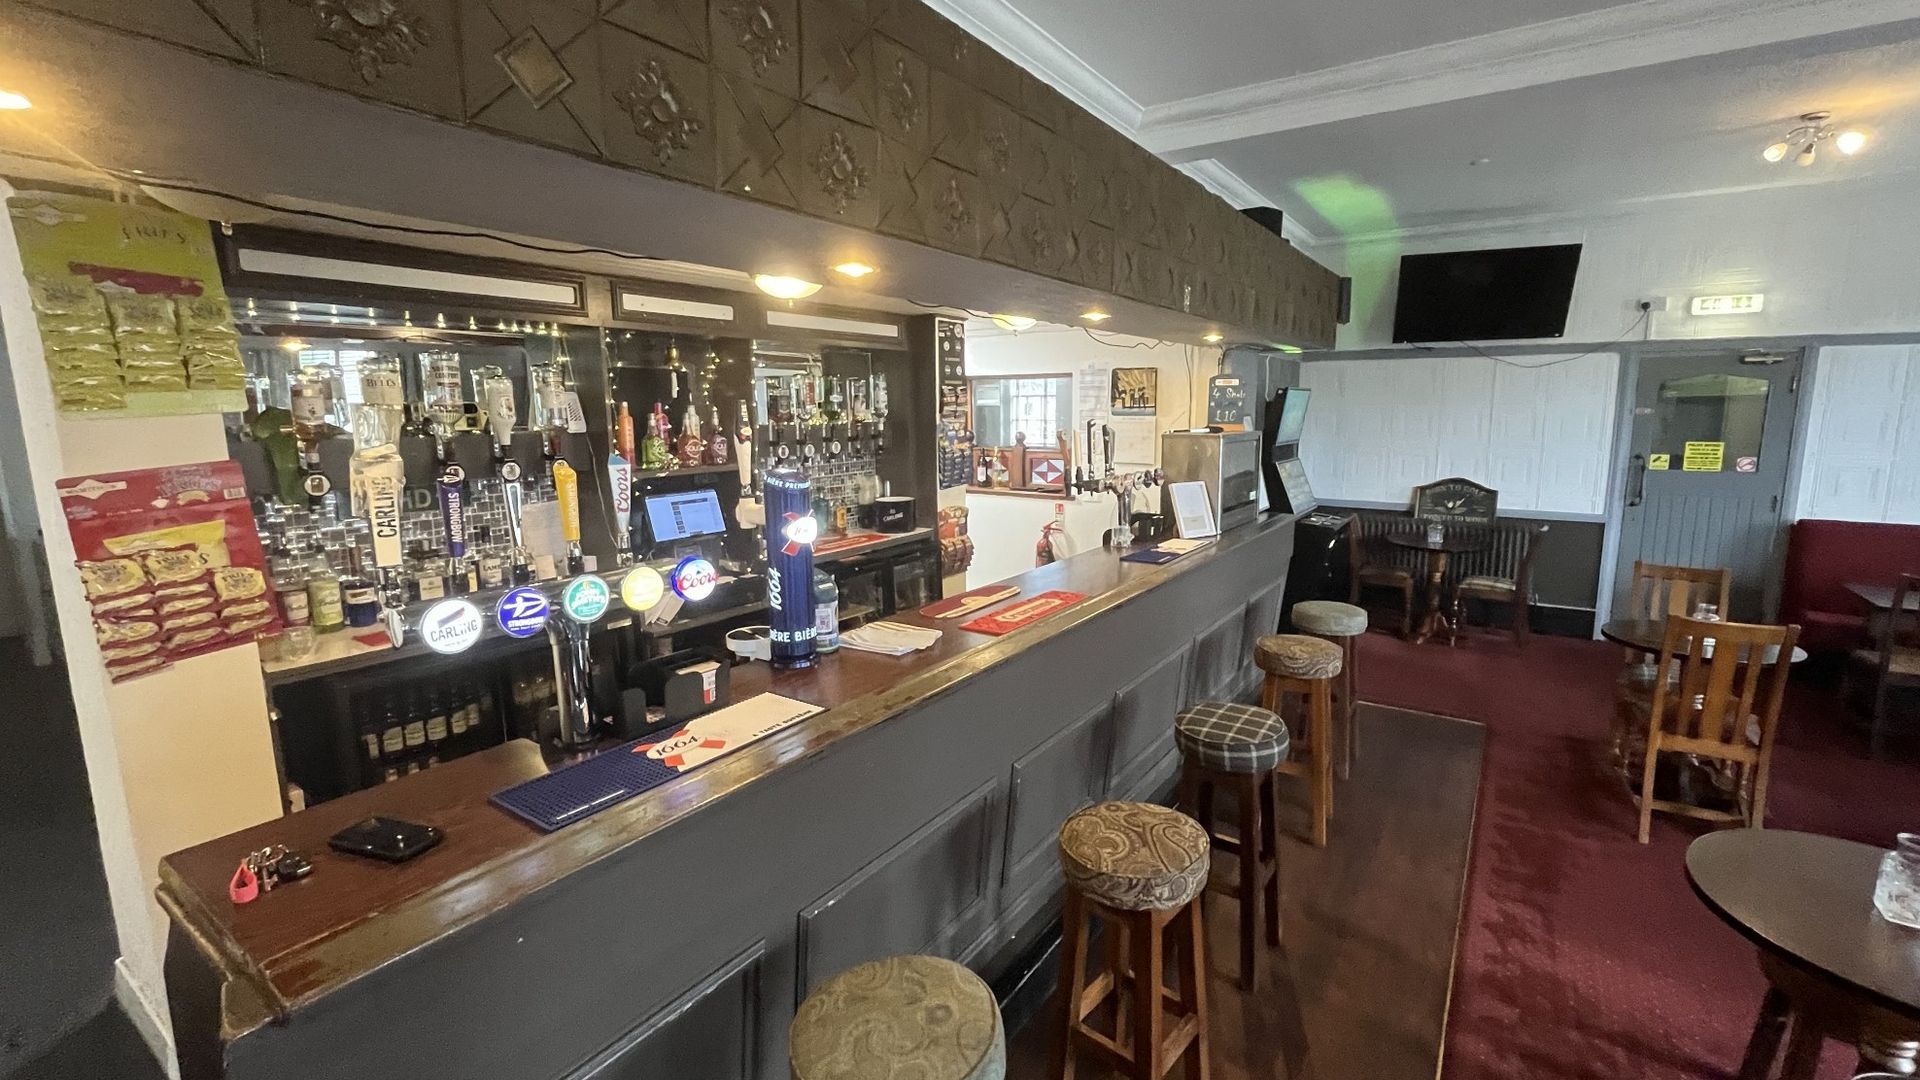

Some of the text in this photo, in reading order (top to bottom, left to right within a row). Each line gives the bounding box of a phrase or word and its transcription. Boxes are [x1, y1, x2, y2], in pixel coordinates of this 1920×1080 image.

[371, 476, 398, 538] CARLING
[448, 492, 463, 543] STRONGBOW
[677, 571, 721, 591] Coors
[768, 567, 782, 611] 1664
[430, 619, 478, 643] CARLING
[655, 735, 699, 757] 1664
